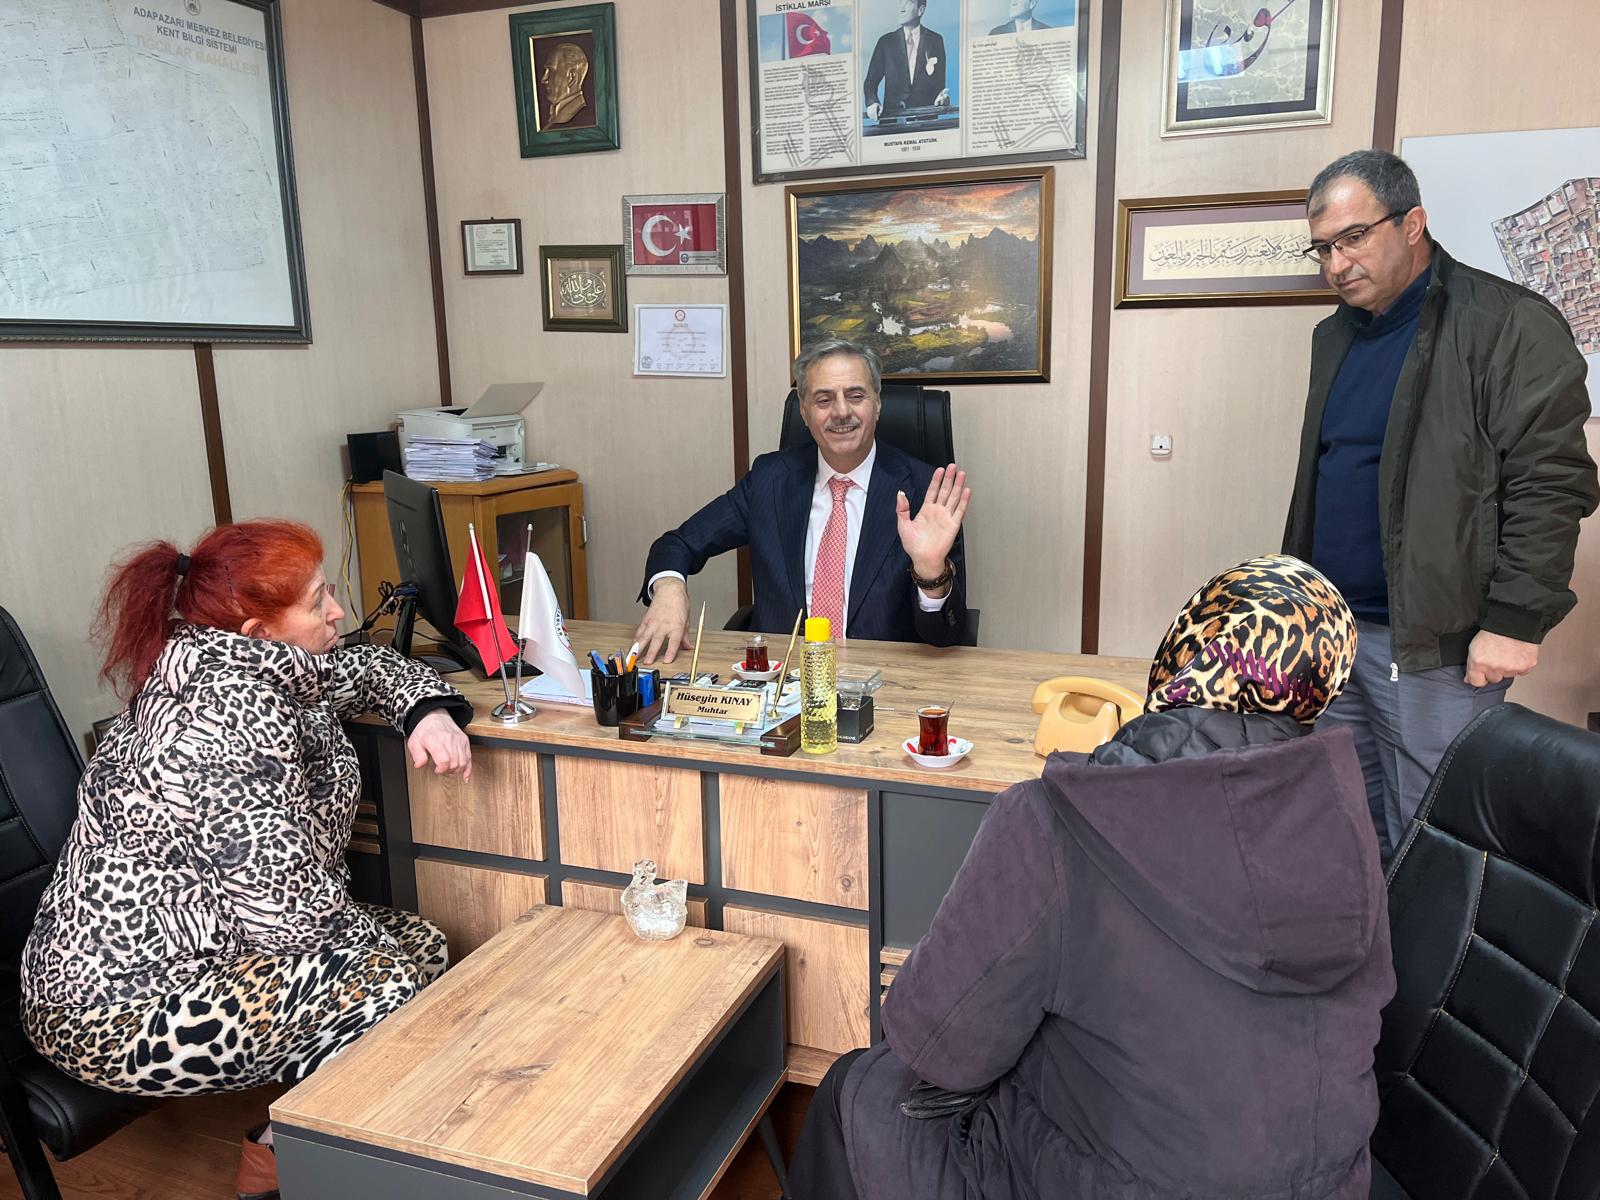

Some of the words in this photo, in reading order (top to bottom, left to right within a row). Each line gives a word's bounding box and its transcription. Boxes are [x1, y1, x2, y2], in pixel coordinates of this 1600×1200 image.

[775, 2, 807, 12] İSTİKLAL
[807, 0, 831, 8] MARŞI
[134, 7, 184, 28] ADAPAZARI
[186, 20, 221, 38] MERKEZ
[157, 25, 180, 39] KENT
[182, 32, 205, 47] BİLGİ
[206, 38, 238, 54] SİSTEMİ
[676, 691, 718, 704] Hüseyin
[720, 695, 753, 706] KINAY
[696, 705, 729, 715] Muhtar
